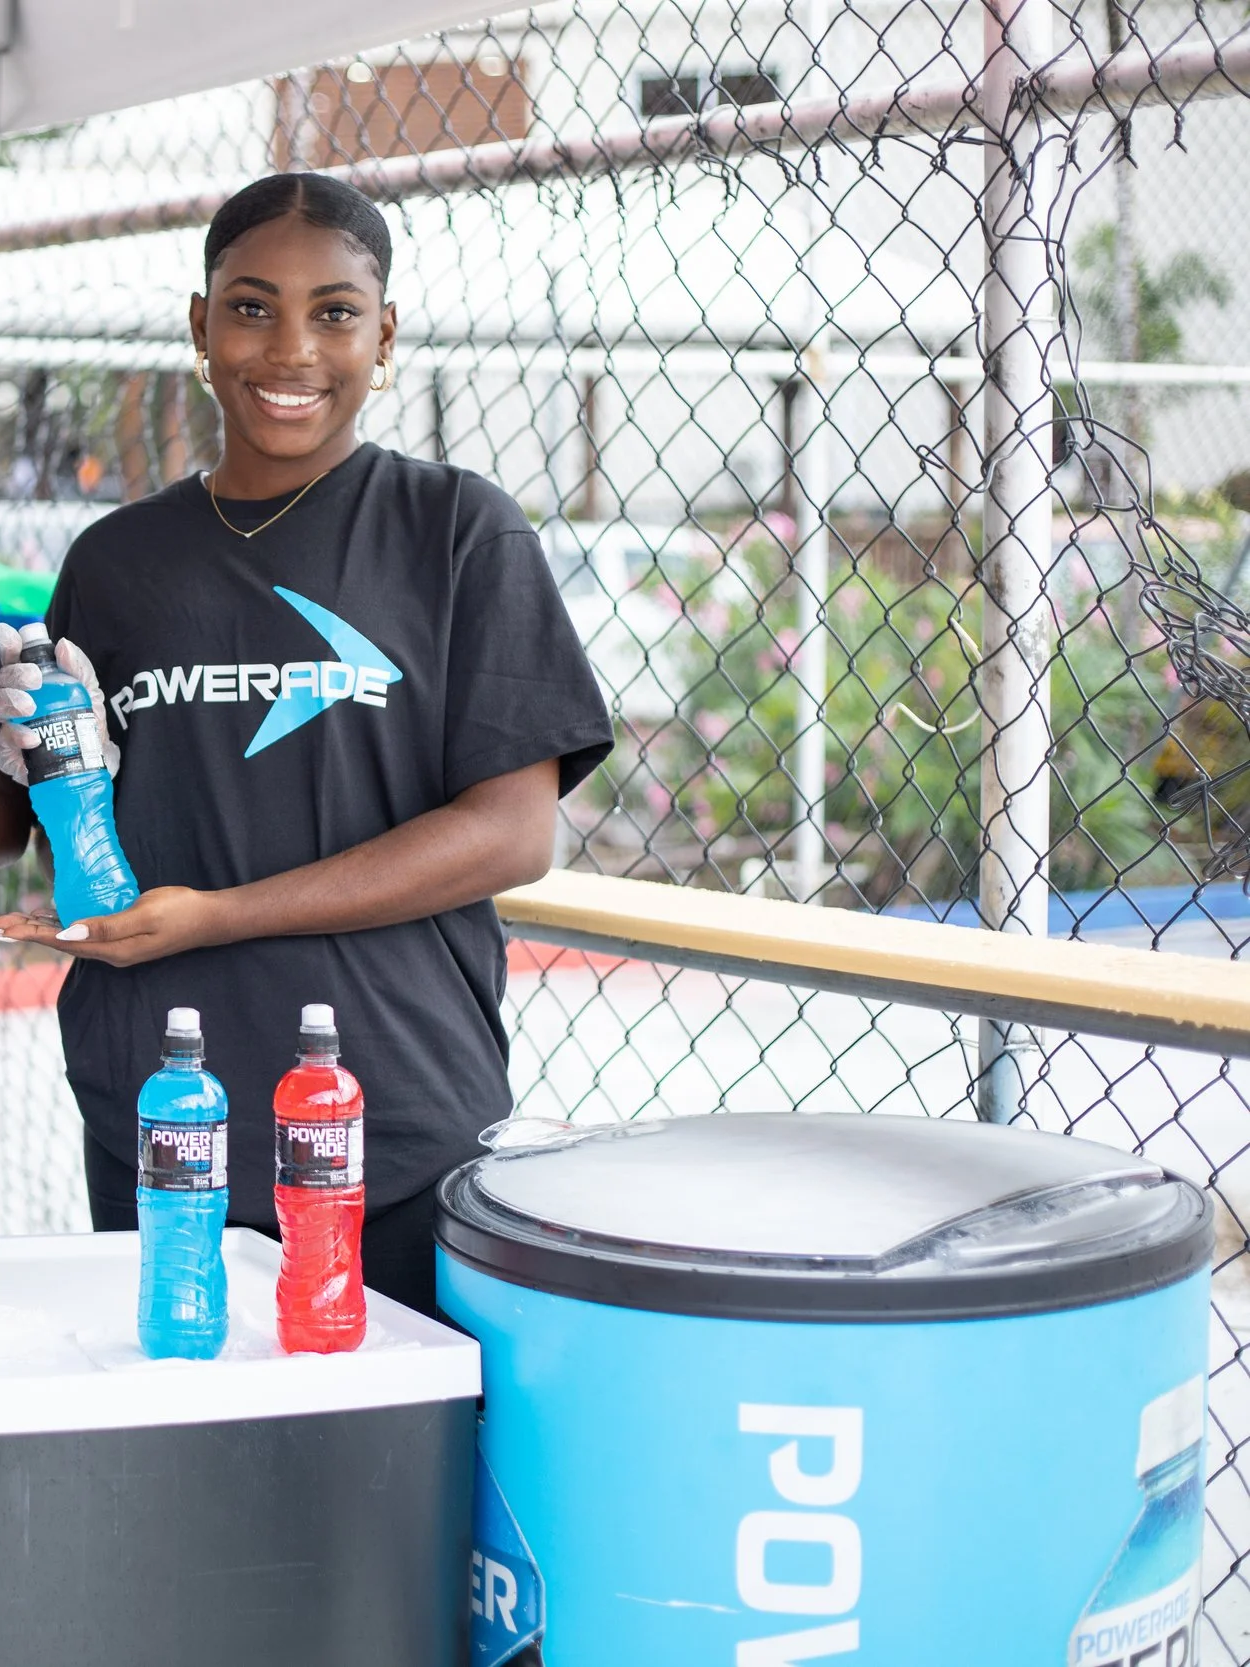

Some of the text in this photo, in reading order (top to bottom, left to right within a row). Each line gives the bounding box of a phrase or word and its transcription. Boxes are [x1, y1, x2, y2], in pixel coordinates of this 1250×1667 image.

[110, 660, 391, 730] POWERADE
[30, 720, 74, 739] OWER
[45, 732, 77, 751] ADE
[152, 1129, 210, 1146] POWER
[288, 1126, 346, 1142] POWER
[177, 1146, 210, 1161] ADE
[313, 1142, 346, 1157] ADE
[1076, 1587, 1191, 1663] POWERADE
